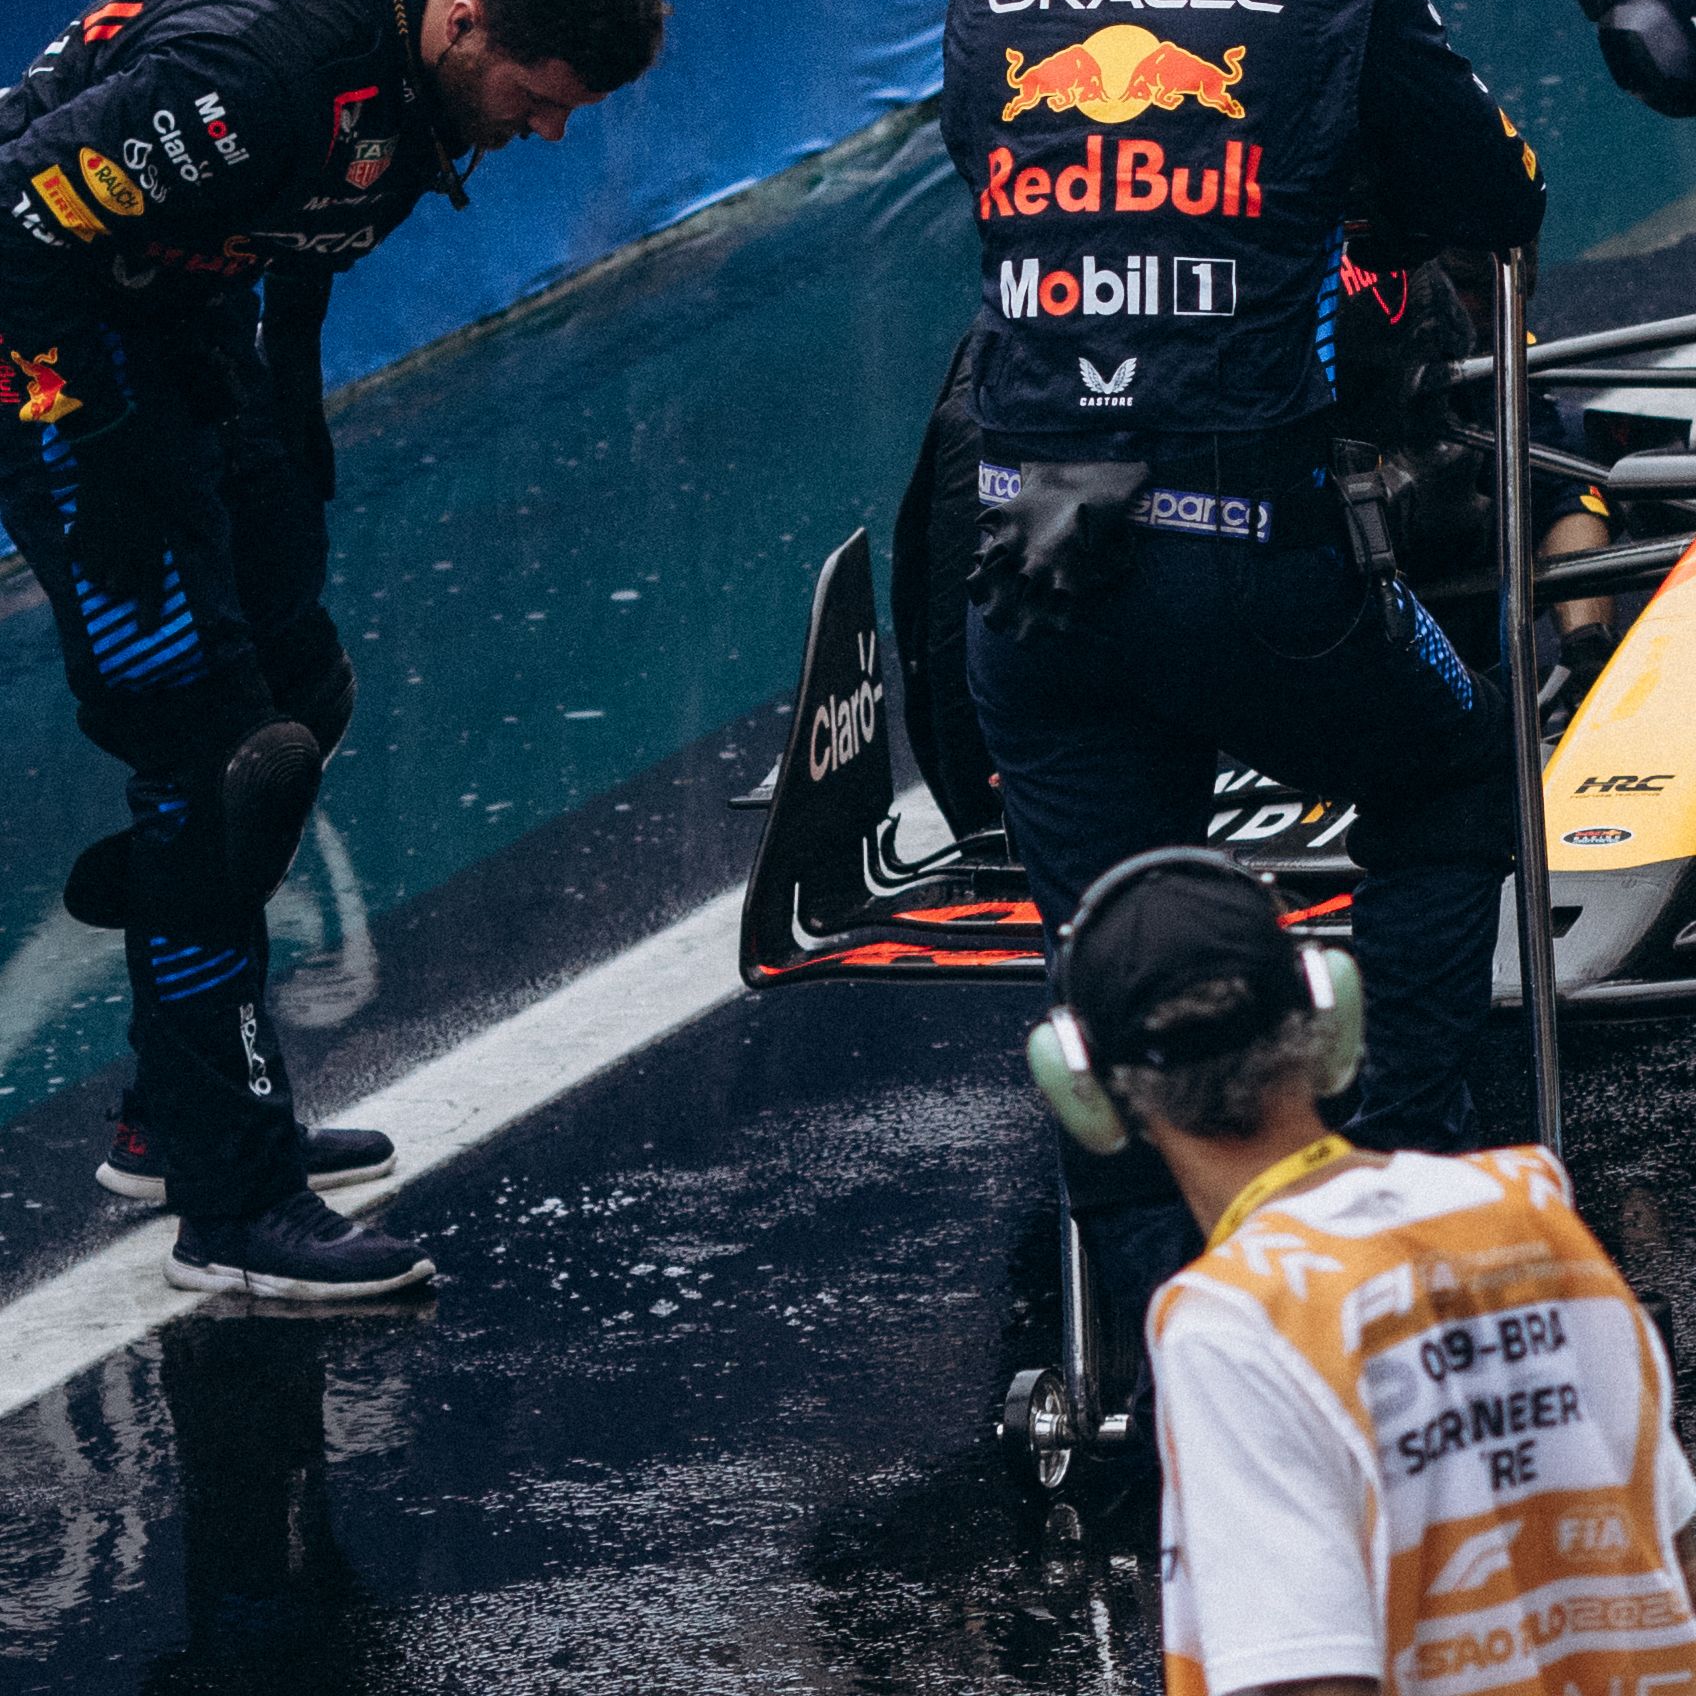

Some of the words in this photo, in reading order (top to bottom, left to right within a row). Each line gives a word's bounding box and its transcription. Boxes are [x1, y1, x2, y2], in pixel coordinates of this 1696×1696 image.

[153, 109, 205, 184] Claro
[195, 92, 249, 166] Mobil
[94, 165, 139, 211] RAUCH
[1000, 256, 1159, 320] Mobil
[1080, 396, 1133, 407] CASTORE
[809, 669, 882, 783] Claro
[1574, 774, 1676, 794] HRC
